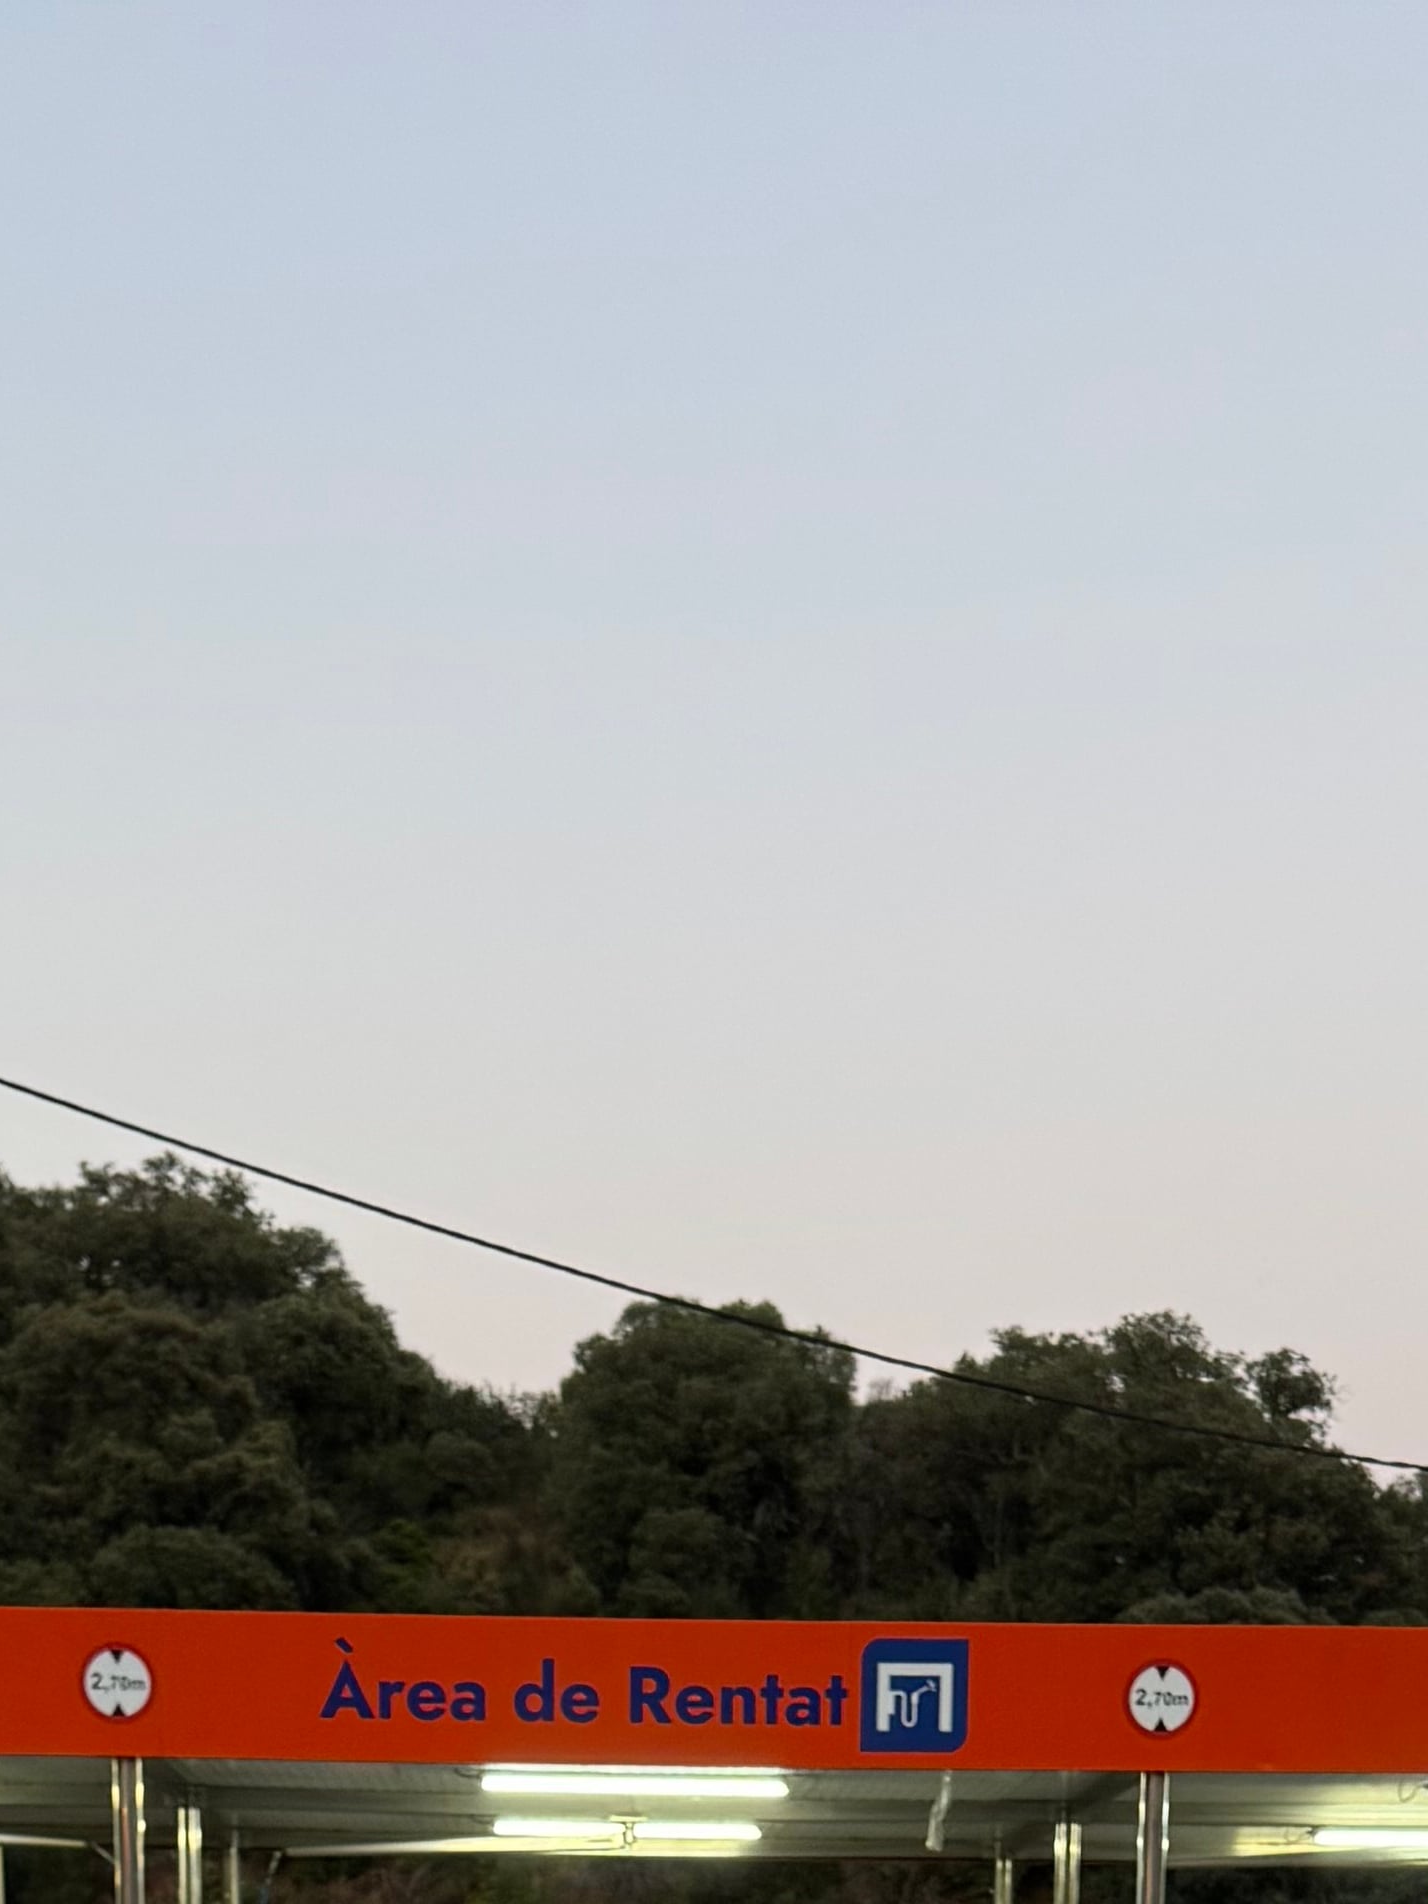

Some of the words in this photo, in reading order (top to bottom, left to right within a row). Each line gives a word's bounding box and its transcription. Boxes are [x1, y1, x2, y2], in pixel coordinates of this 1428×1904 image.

[321, 1637, 486, 1721] Àrea
[514, 1659, 599, 1723] de
[629, 1667, 848, 1726] Rentat
